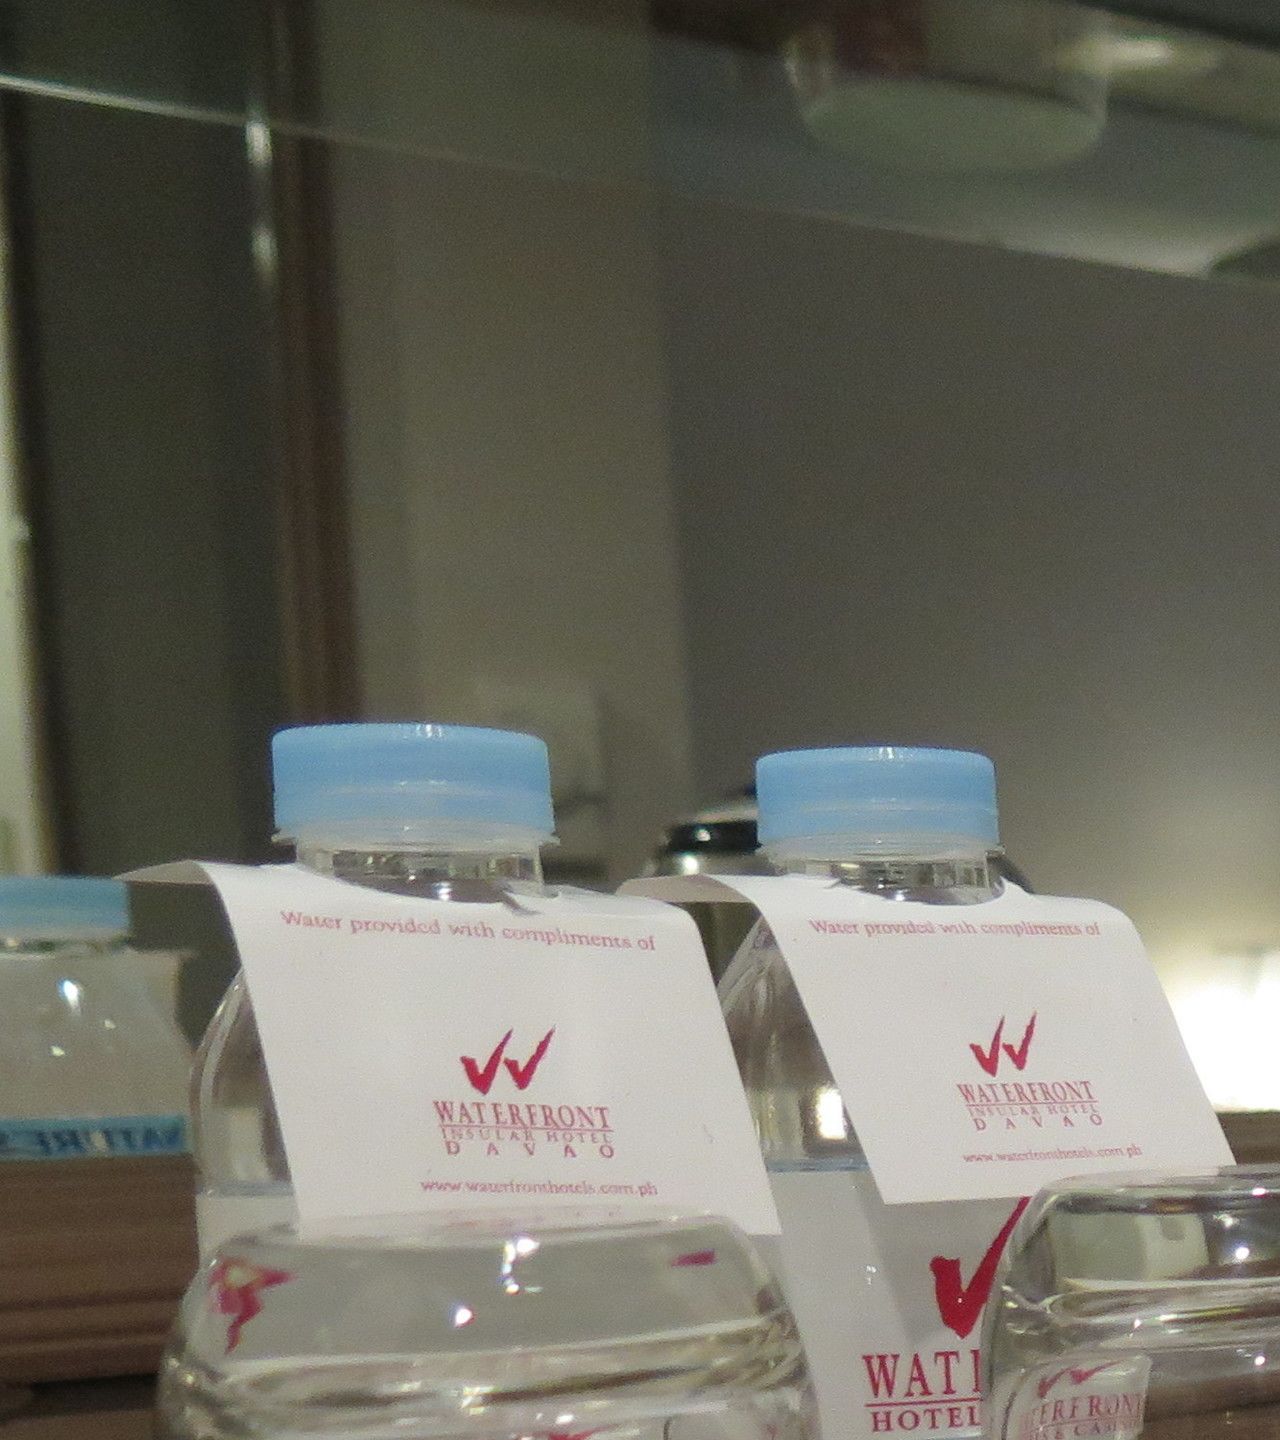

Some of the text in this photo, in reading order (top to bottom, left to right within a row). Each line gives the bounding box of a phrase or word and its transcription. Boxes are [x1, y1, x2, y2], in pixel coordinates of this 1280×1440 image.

[280, 909, 656, 951] Water provided with compliments of
[808, 919, 1102, 938] Water provided with compliments of
[956, 1080, 1096, 1103] WATERFRONT
[432, 1100, 611, 1128] WATERFRONT
[546, 1131, 614, 1145] HOTEL
